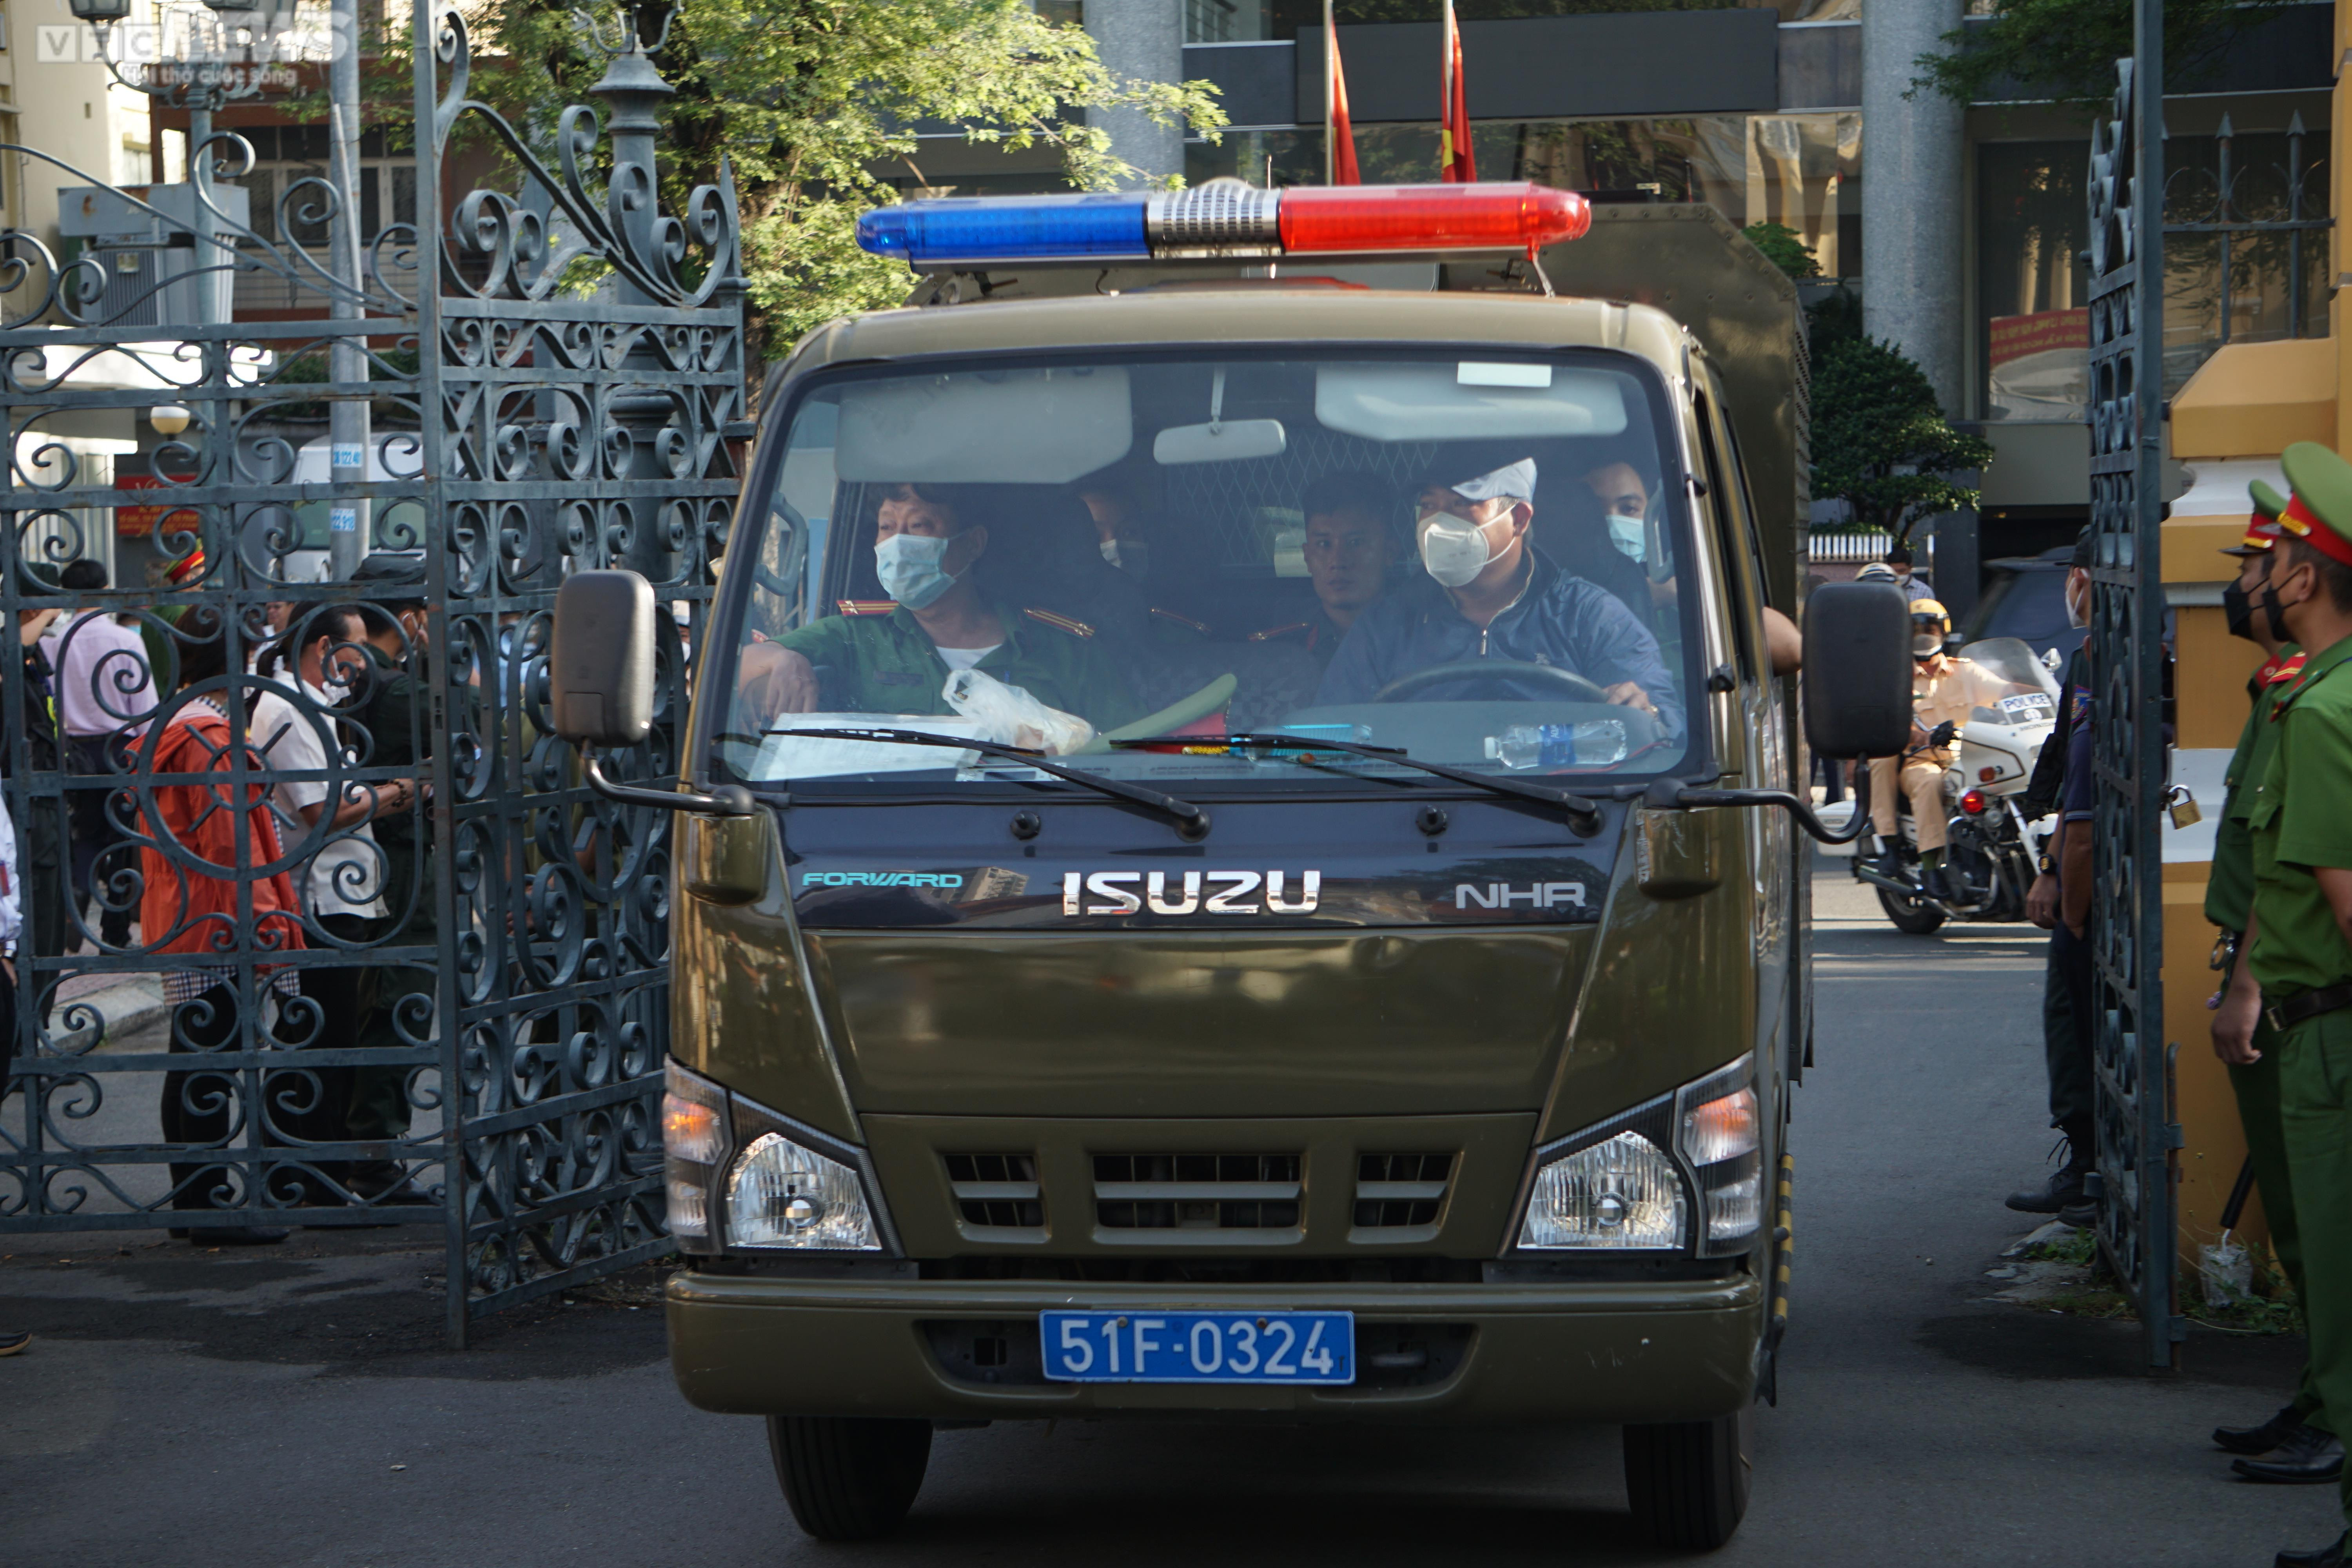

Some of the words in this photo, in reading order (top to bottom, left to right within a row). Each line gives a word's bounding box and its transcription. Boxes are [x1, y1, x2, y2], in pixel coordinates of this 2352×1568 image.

[2004, 695, 2049, 710] POLICE
[802, 873, 963, 887] FORWARD
[1064, 871, 1321, 916] ISUZU
[1455, 882, 1586, 909] NHR
[1060, 1319, 1333, 1375] 51F-0324
